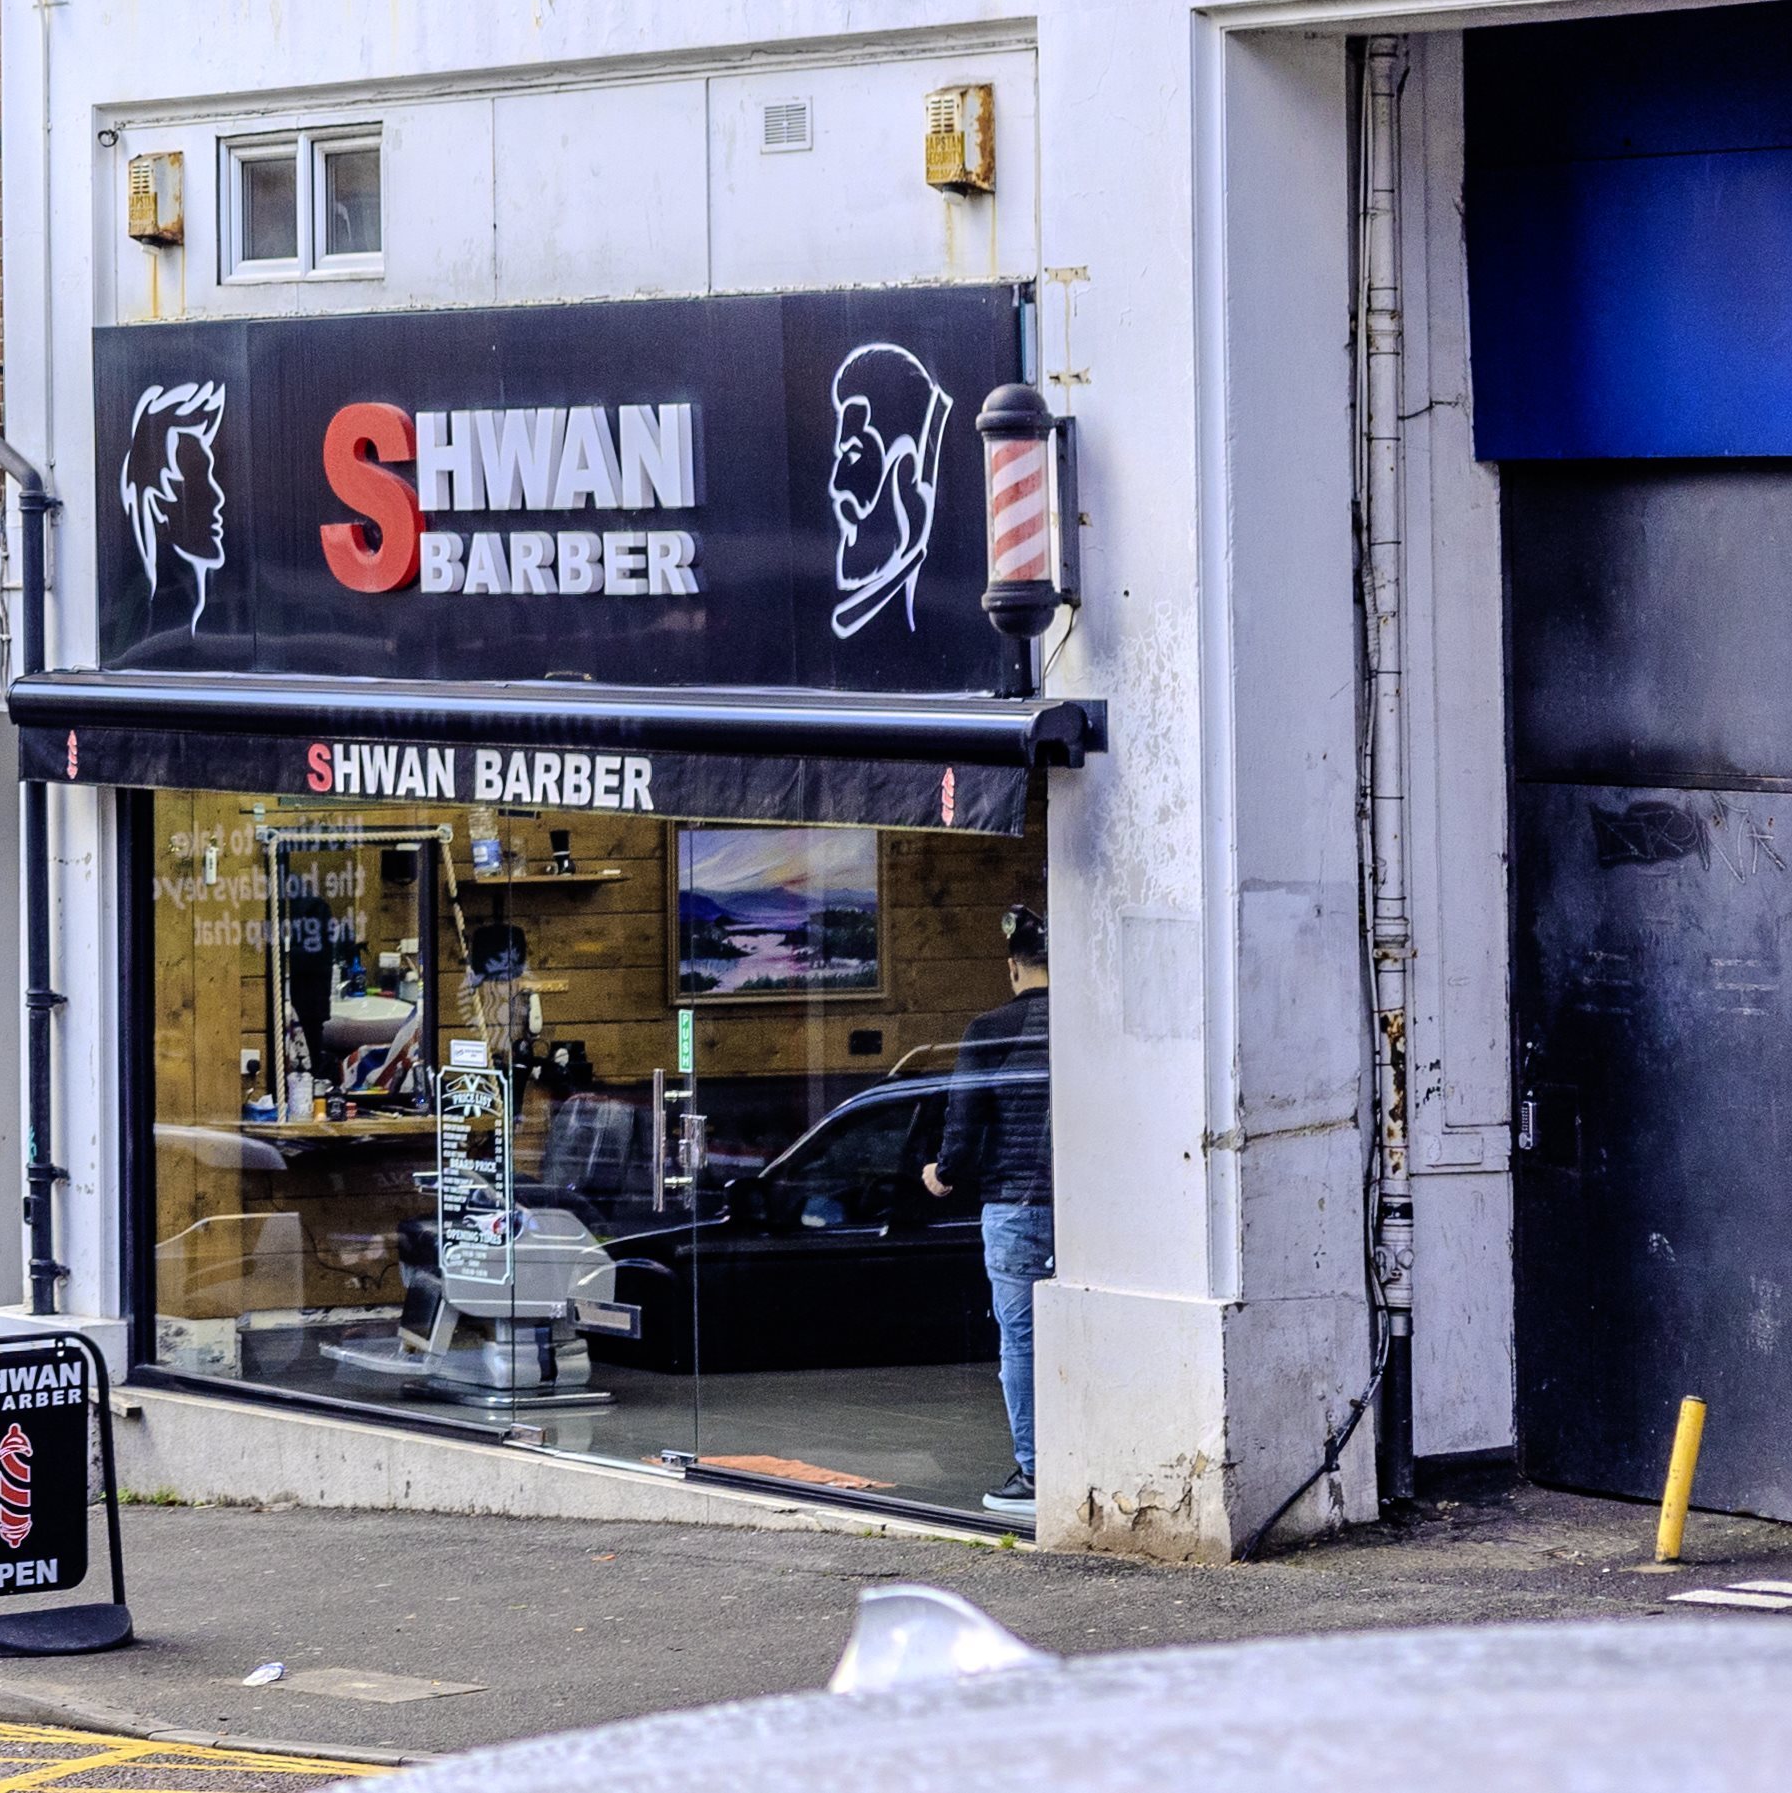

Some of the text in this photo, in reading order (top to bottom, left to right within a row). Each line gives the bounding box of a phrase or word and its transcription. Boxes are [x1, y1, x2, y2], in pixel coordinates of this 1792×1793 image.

[321, 402, 696, 594] SHWAN
[418, 529, 701, 596] BARBER
[307, 743, 654, 811] SHWAN BARBER
[451, 1092, 493, 1108] PRICE LIST
